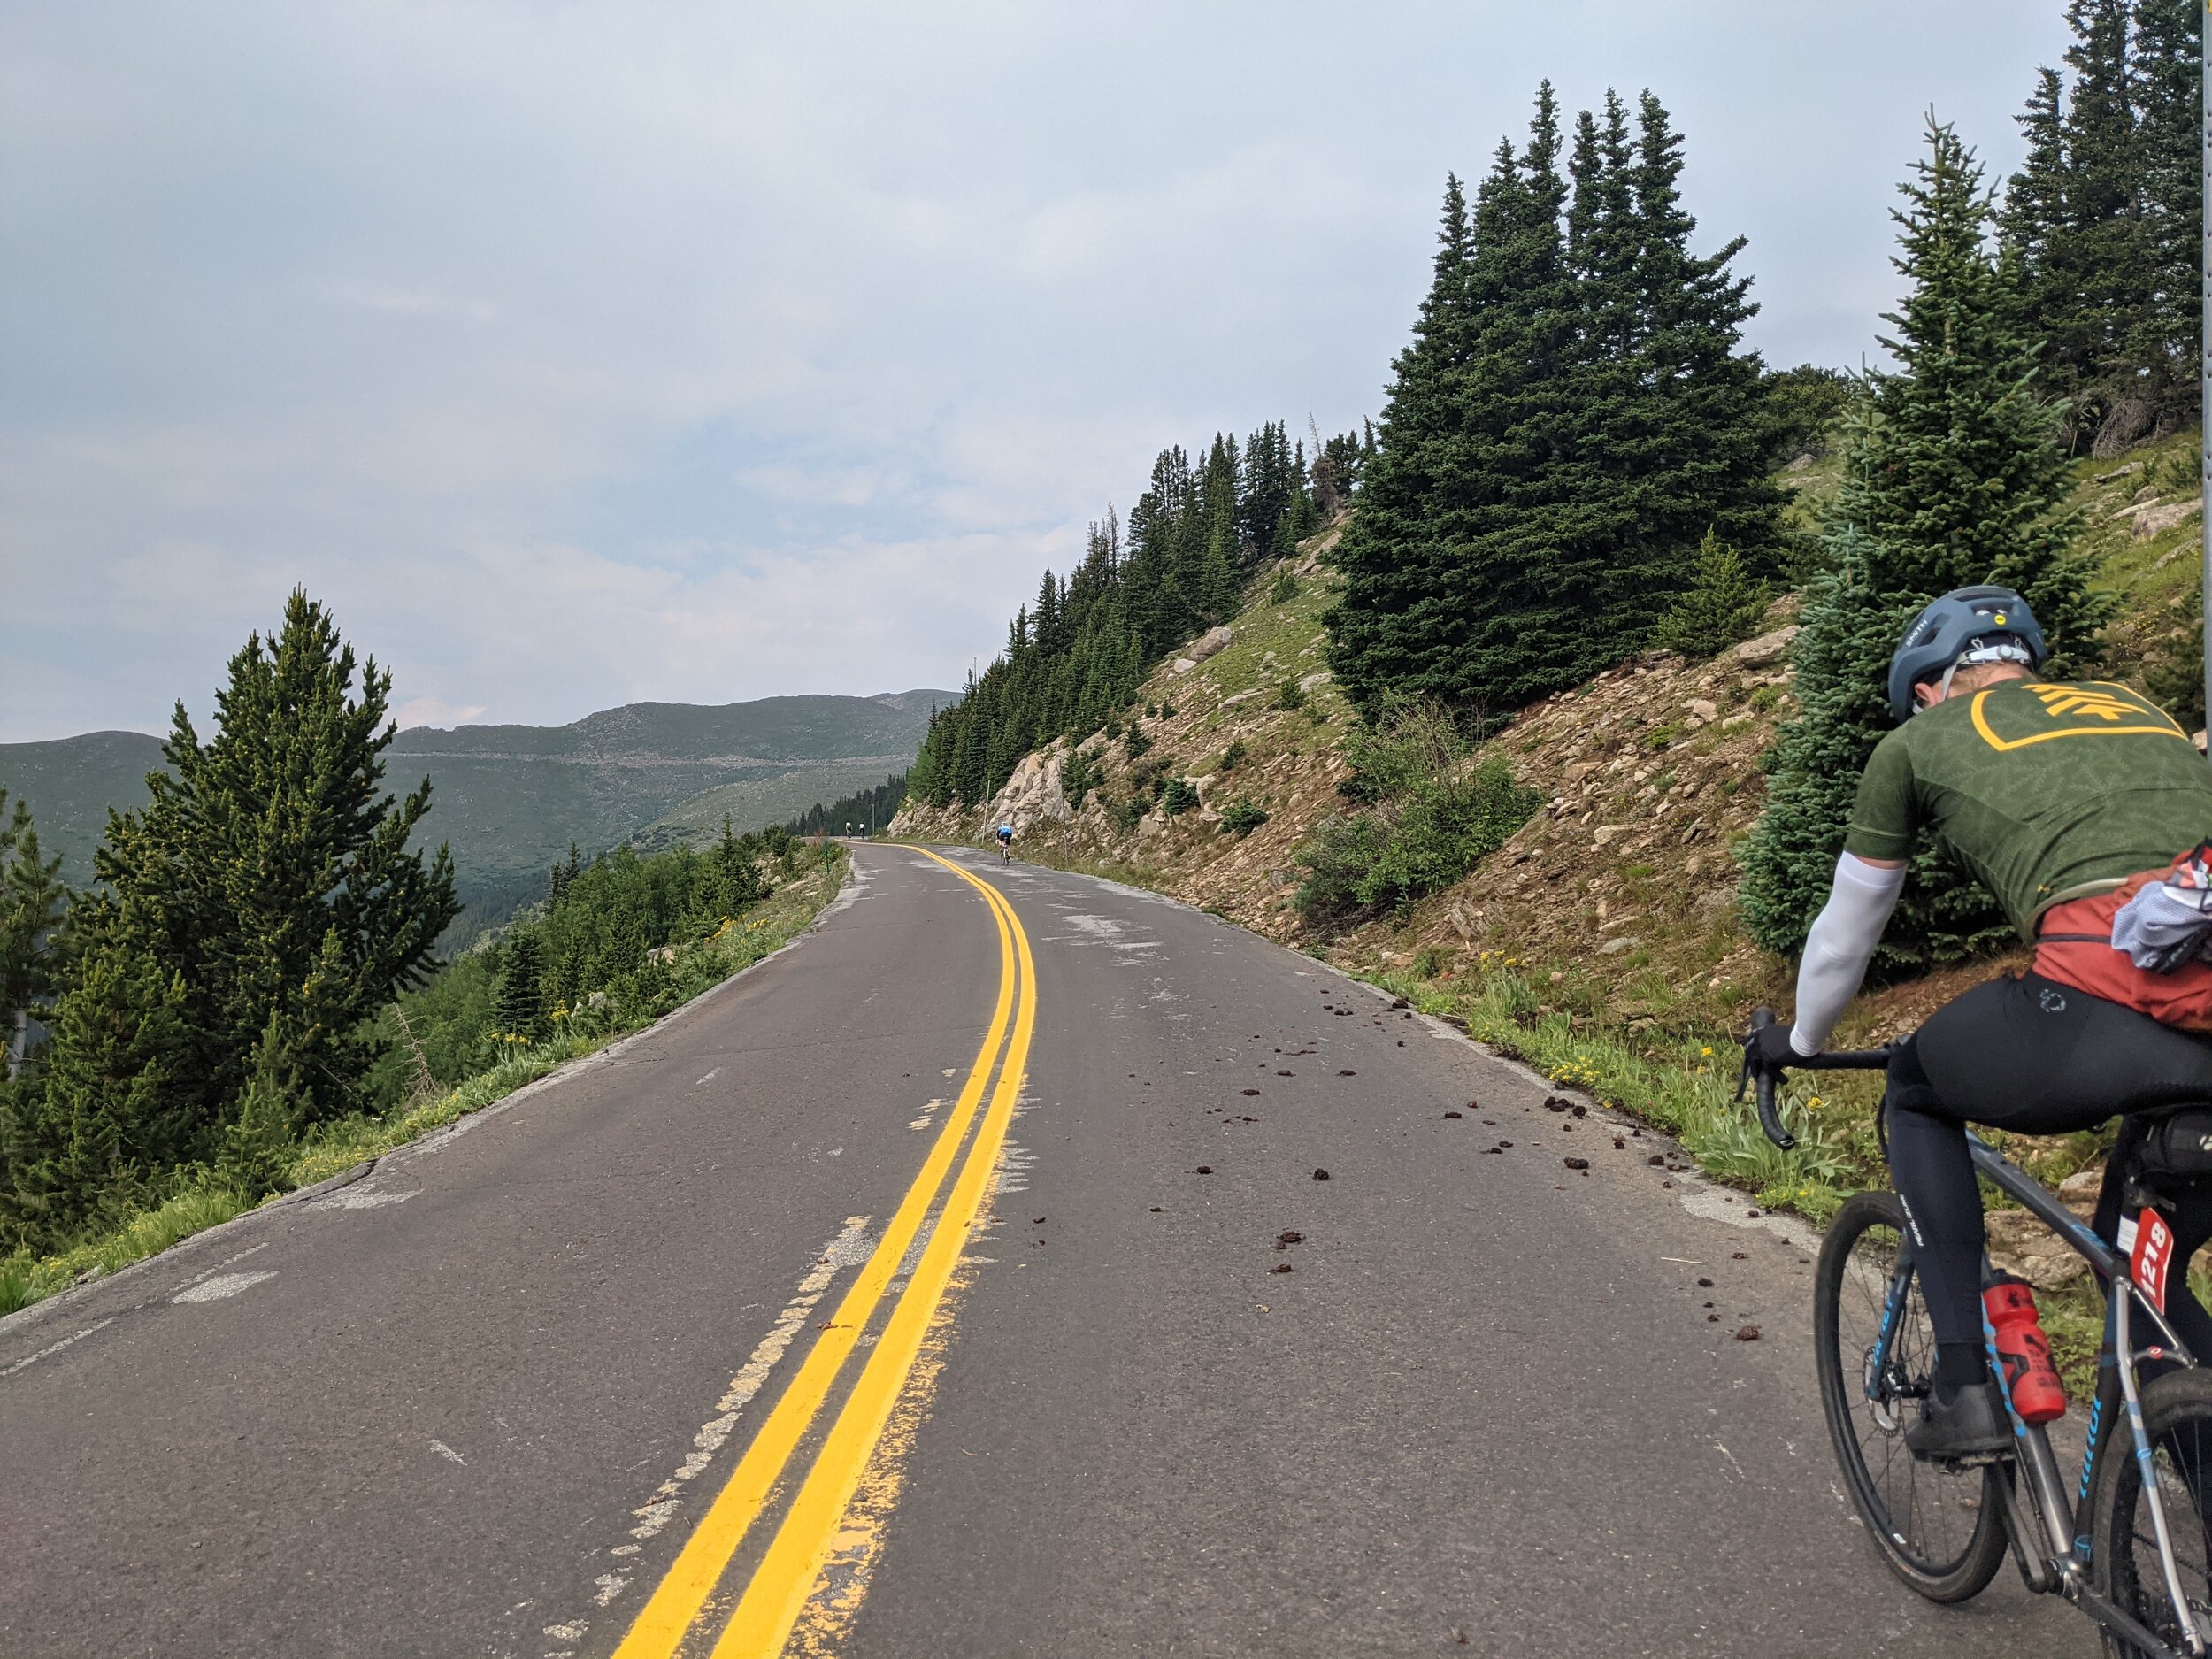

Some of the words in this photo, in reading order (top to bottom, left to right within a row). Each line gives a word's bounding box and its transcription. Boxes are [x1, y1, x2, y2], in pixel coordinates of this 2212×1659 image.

[1905, 619, 1928, 647] SMITH
[1909, 1219, 1924, 1247] PEARL
[2140, 1221, 2166, 1298] 1218
